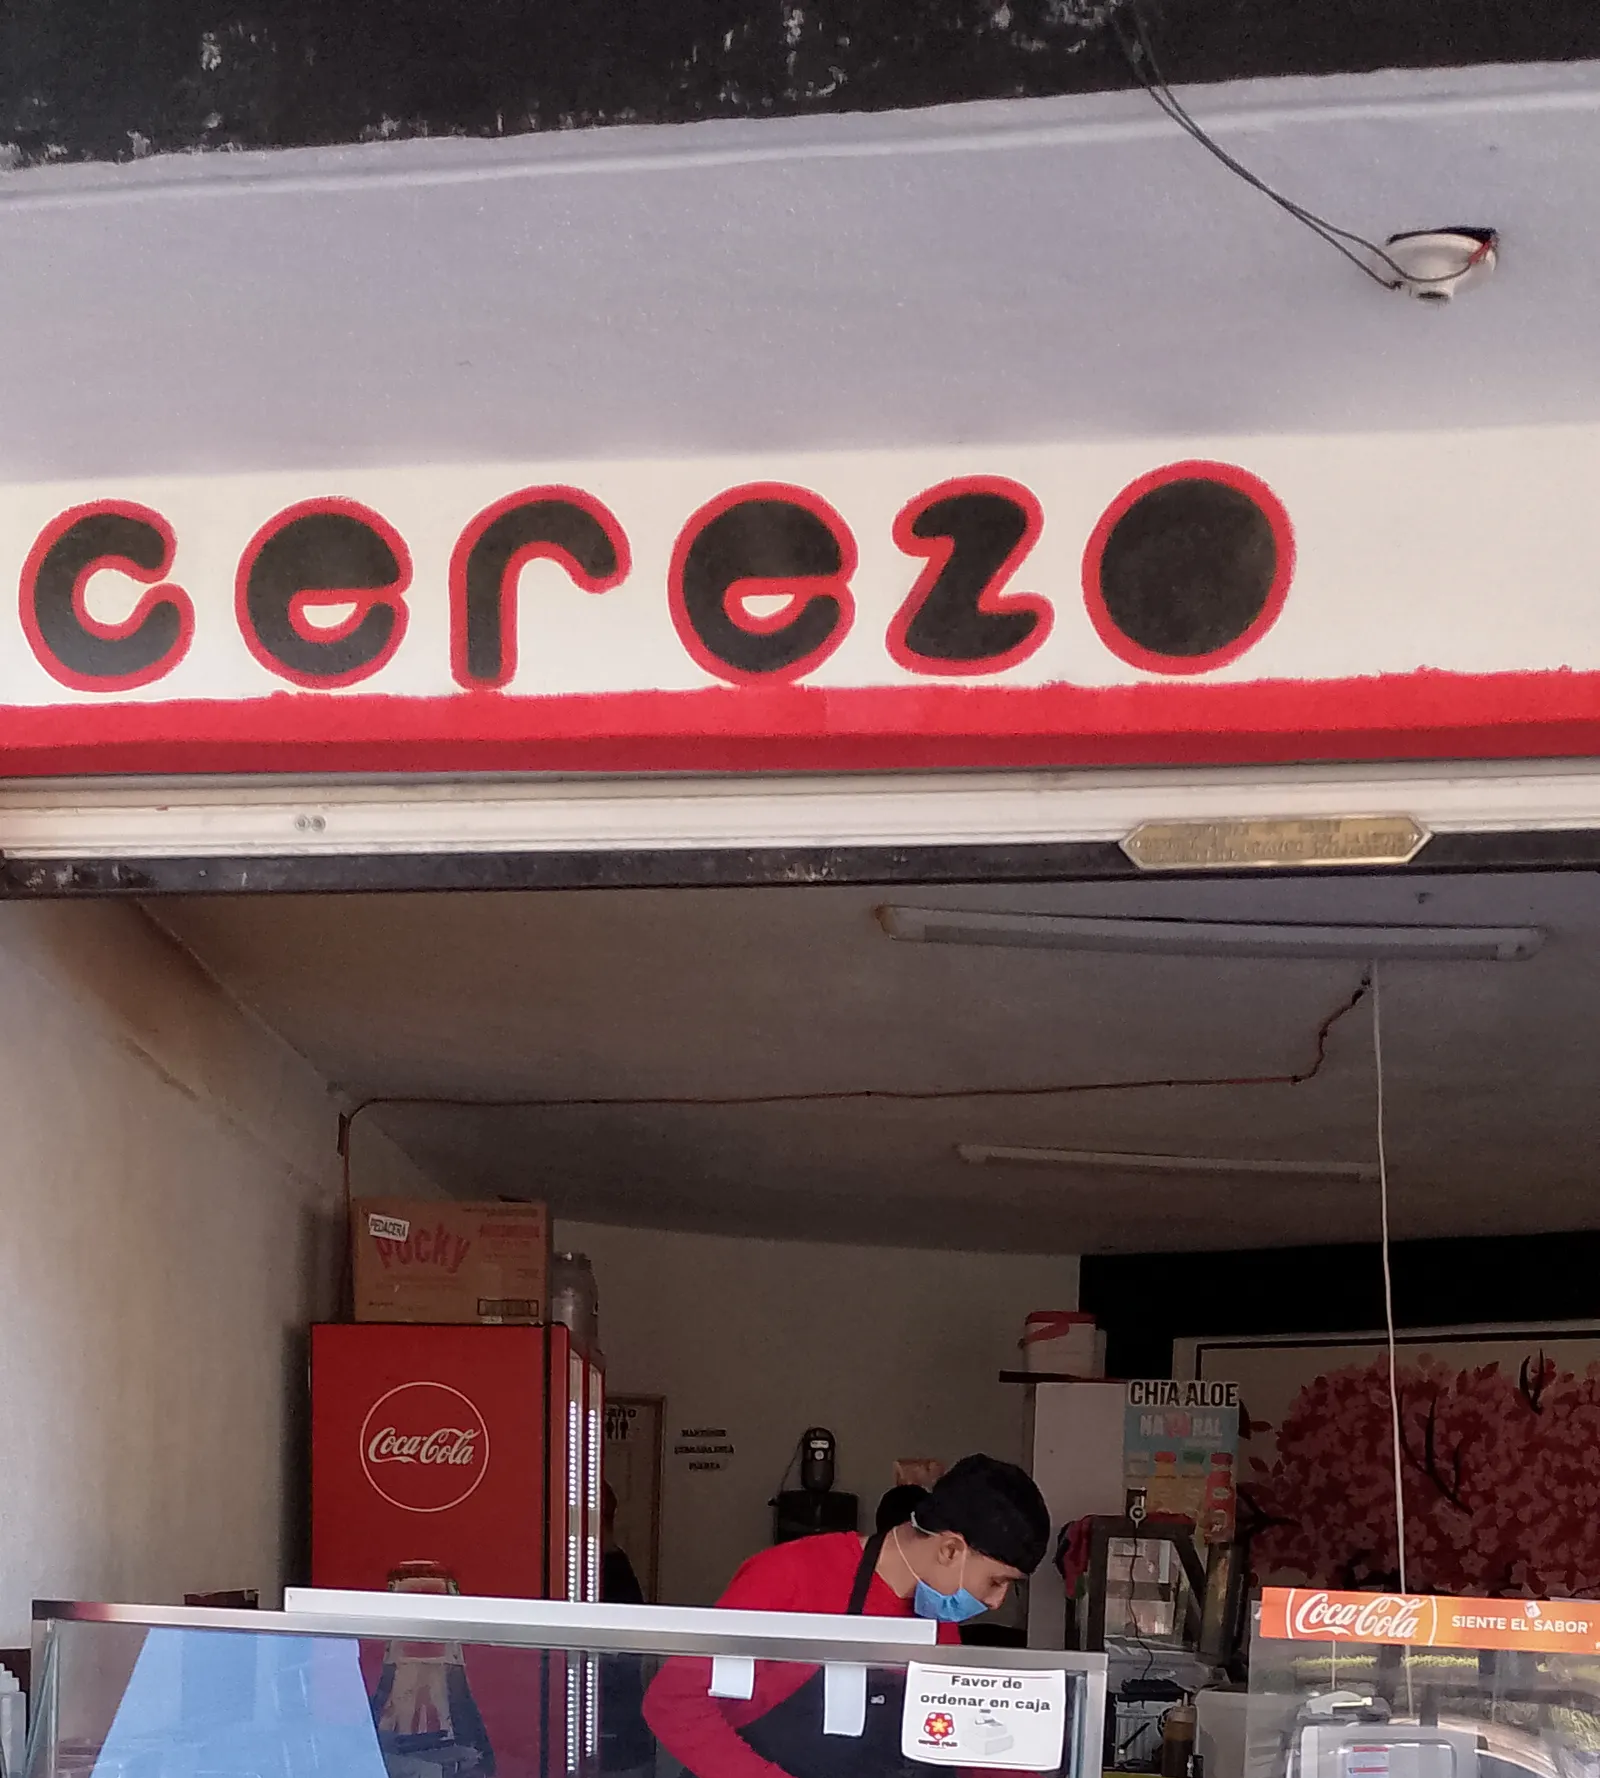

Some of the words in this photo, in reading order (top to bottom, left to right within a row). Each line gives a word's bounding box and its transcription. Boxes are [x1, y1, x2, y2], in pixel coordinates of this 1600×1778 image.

[1185, 1382, 1239, 1407] ALOE
[368, 1426, 481, 1465] Coca-Cola
[1294, 1593, 1426, 1639] Coca-Cola
[1451, 1615, 1507, 1630] SIENTE
[1511, 1618, 1530, 1632] EL
[951, 1675, 998, 1688] Favor
[1002, 1676, 1023, 1689] de
[920, 1693, 986, 1708] ordenar
[989, 1700, 1010, 1709] en
[1015, 1699, 1052, 1713] caja
